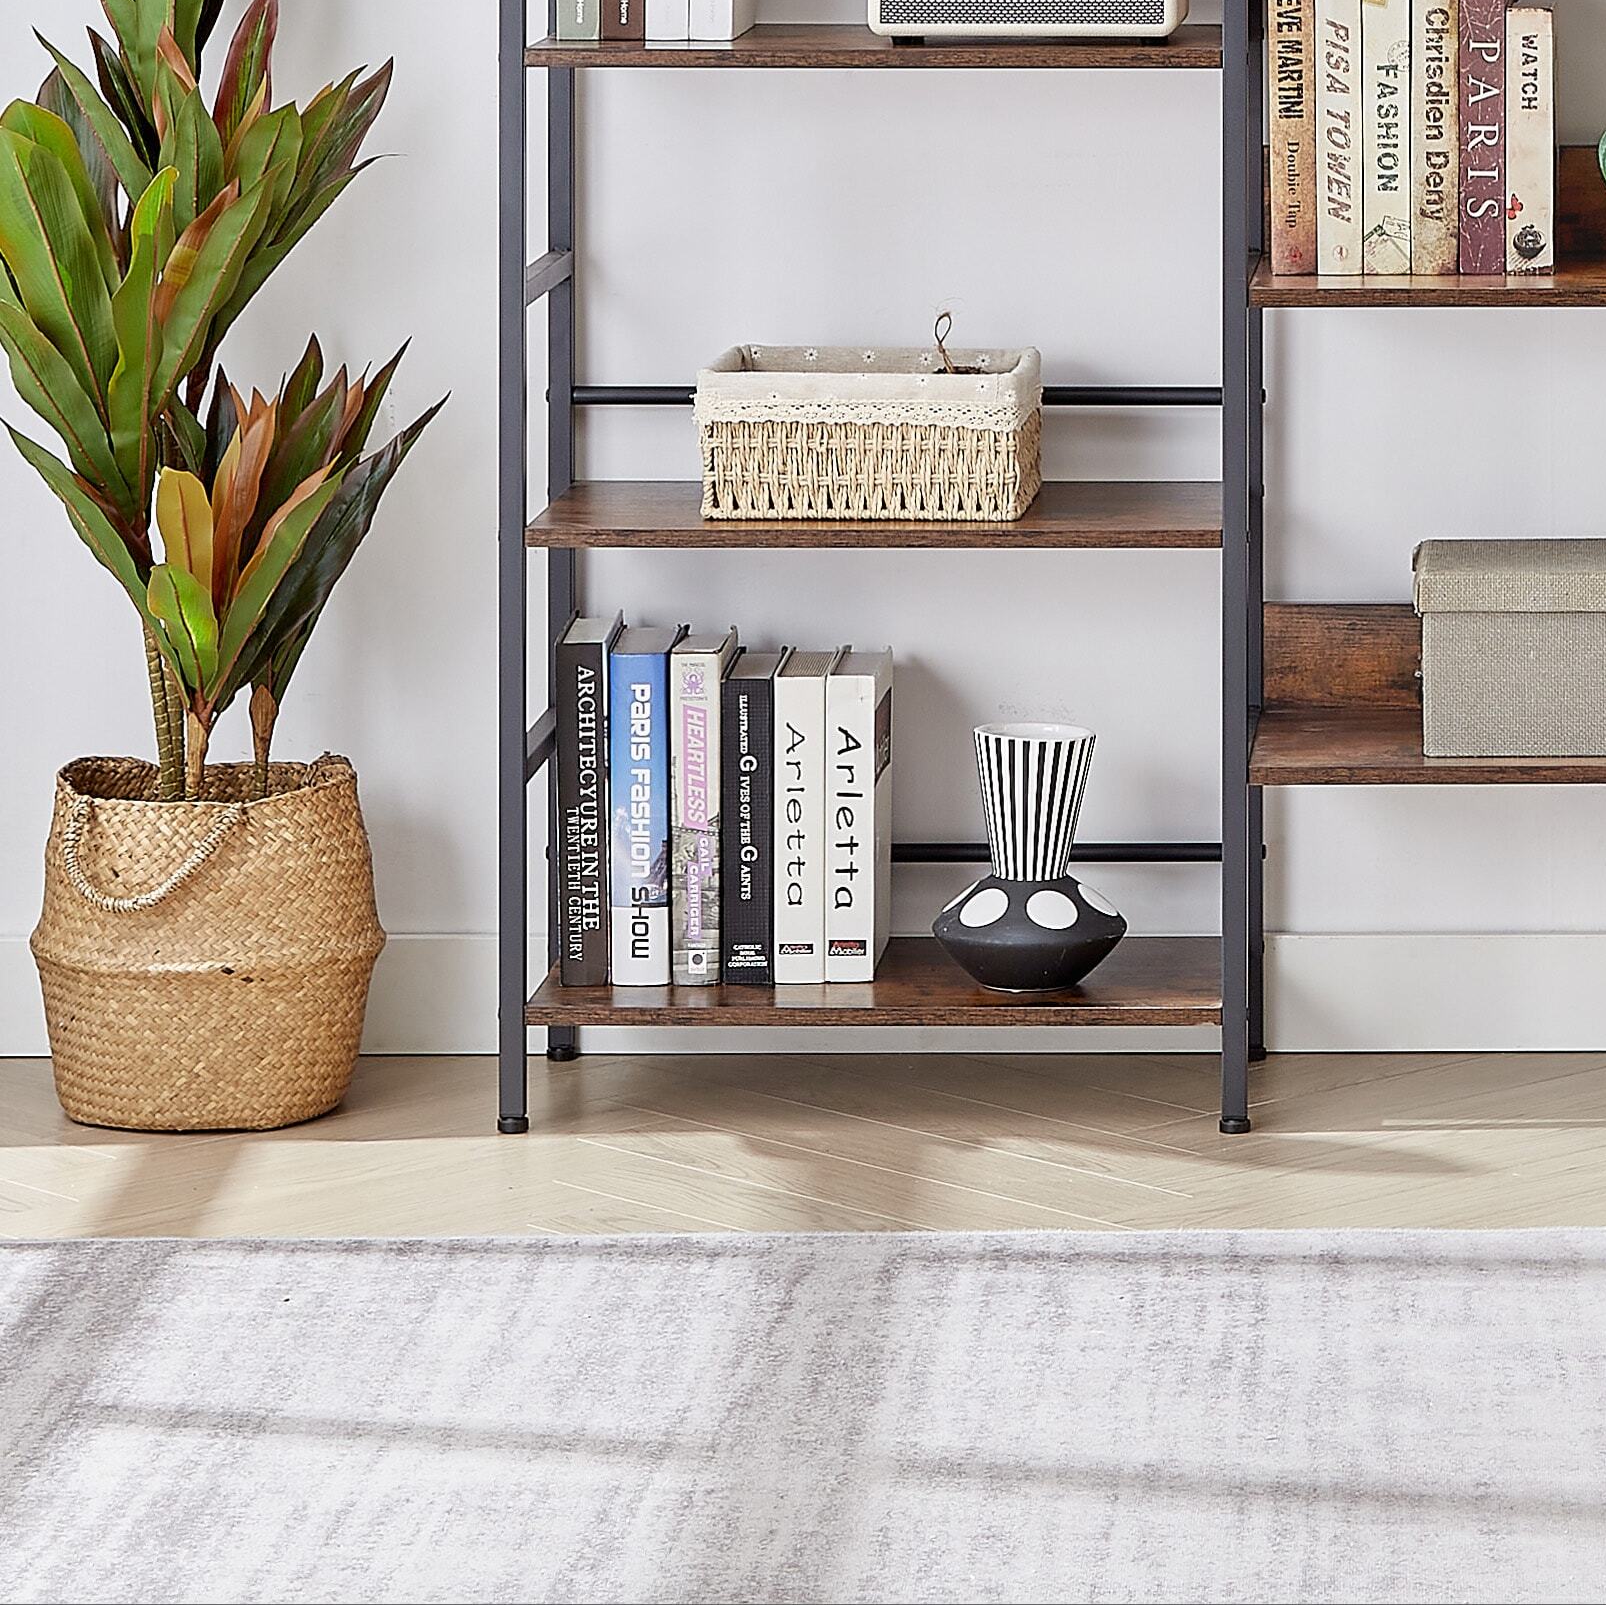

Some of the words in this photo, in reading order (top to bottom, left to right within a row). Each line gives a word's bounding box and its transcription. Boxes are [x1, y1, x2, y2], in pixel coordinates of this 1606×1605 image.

[620, 0, 629, 25] Home
[1277, 39, 1304, 120] MARTINI
[1325, 18, 1351, 94] PISA
[1425, 7, 1450, 141] Chrisdien
[1519, 33, 1539, 111] WATCH
[1376, 63, 1399, 192] FASHION
[1467, 39, 1501, 219] PARIS
[1284, 199, 1301, 230] Tap
[1419, 151, 1450, 222] Deny
[577, 665, 598, 847] ARCHITECYURE
[739, 694, 748, 754] ILLUSTRATED
[686, 709, 706, 824] HEARTLESS
[566, 806, 581, 891] TWENTIETH
[786, 722, 806, 906] Arletta
[834, 726, 863, 910] Arletta
[581, 851, 599, 878] IN
[699, 837, 709, 873] GAIL
[568, 896, 583, 961] CENTURY
[582, 881, 600, 931] THE
[689, 865, 700, 937] CARRIGER
